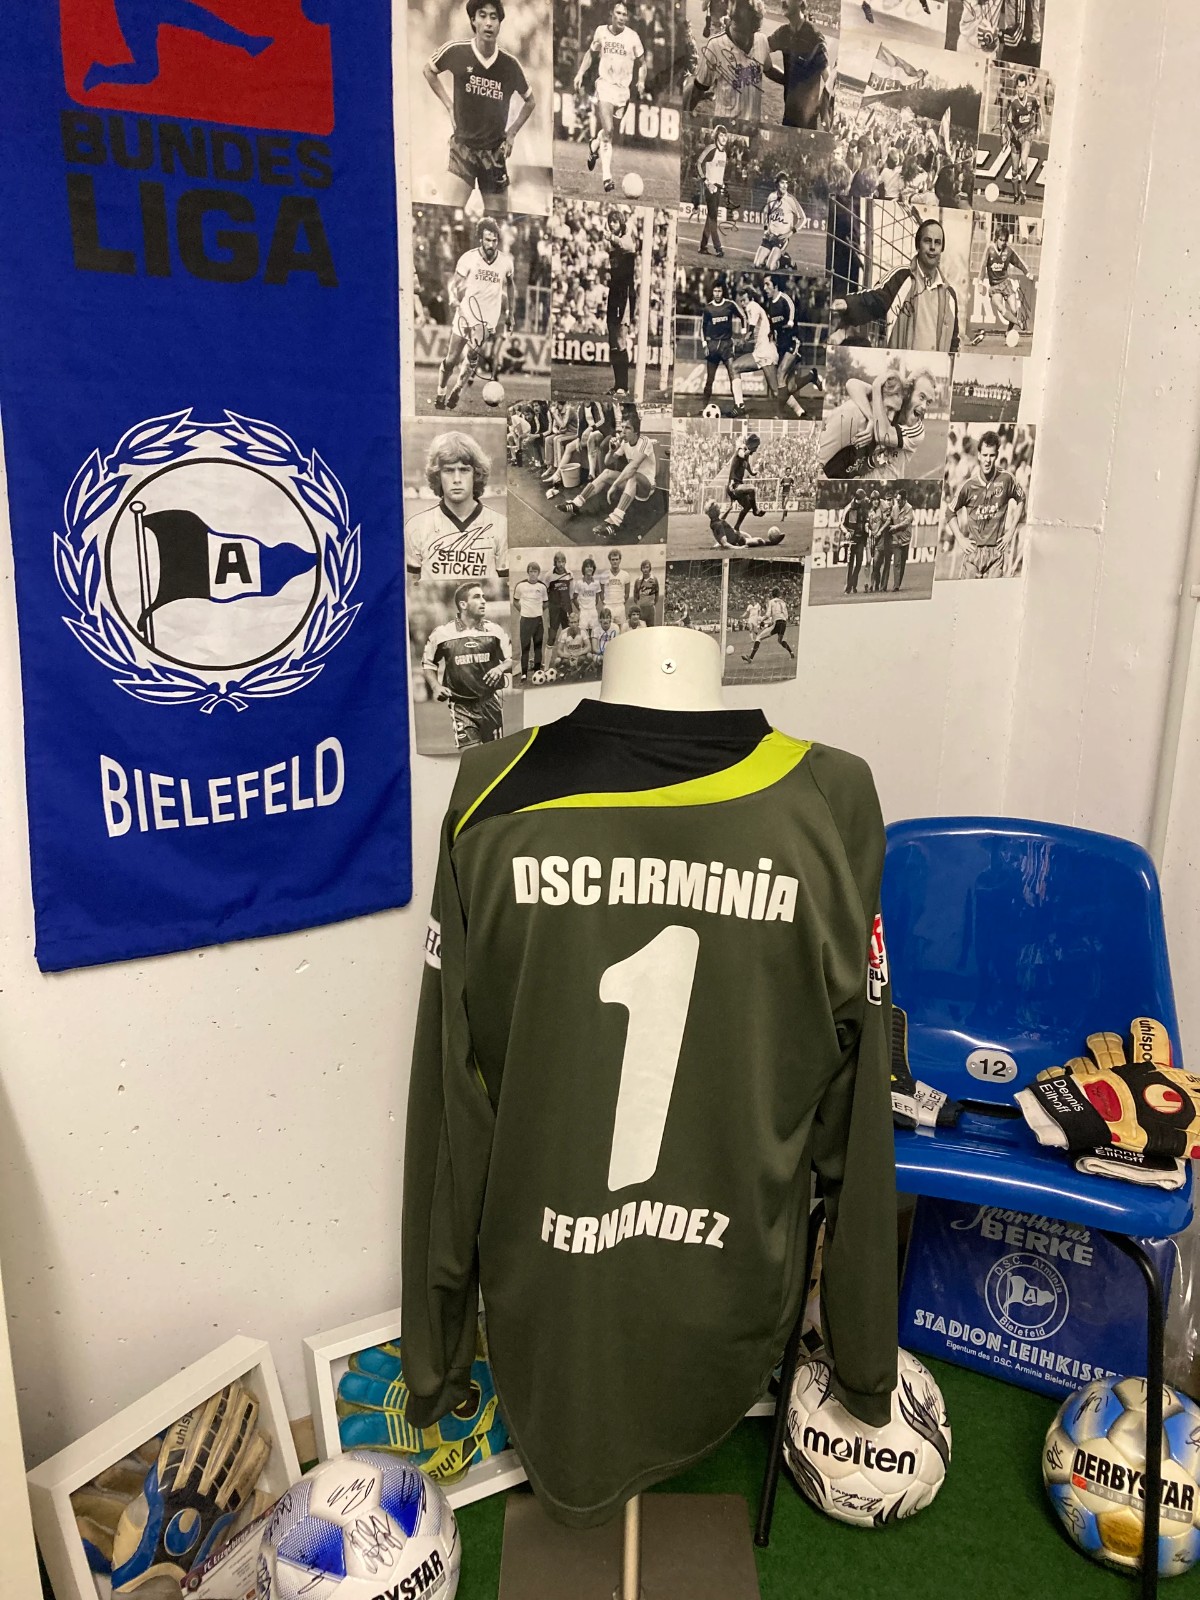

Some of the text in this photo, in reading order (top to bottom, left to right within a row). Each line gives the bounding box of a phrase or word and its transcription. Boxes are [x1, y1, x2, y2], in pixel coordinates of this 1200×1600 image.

[465, 83, 504, 100] STICKER
[470, 75, 502, 91] SEIDEN
[60, 110, 334, 190] BUNDES
[66, 172, 340, 288] LIGA
[215, 543, 252, 584] A
[432, 562, 488, 577] STICKER
[438, 550, 485, 564] SEIDEN
[100, 736, 345, 837] BIELEFELD
[512, 856, 601, 906] DSC
[599, 924, 700, 1192] 1
[979, 1058, 1007, 1078] 12
[1039, 1083, 1072, 1114] Eilhoff
[1053, 1079, 1084, 1112] Dennis
[541, 1200, 730, 1254] FERNANDEZ
[980, 1216, 1094, 1267] BERKE
[1032, 1258, 1063, 1294] Arminia
[913, 1308, 1124, 1382] STADION-LEIHKISS
[999, 1316, 1046, 1338] Bielefeld
[946, 1339, 977, 1357] Eigentum
[978, 1351, 991, 1361] des
[1015, 1362, 1042, 1378] Arminia
[1044, 1372, 1077, 1390] Bielefeld
[803, 1426, 916, 1475] molten
